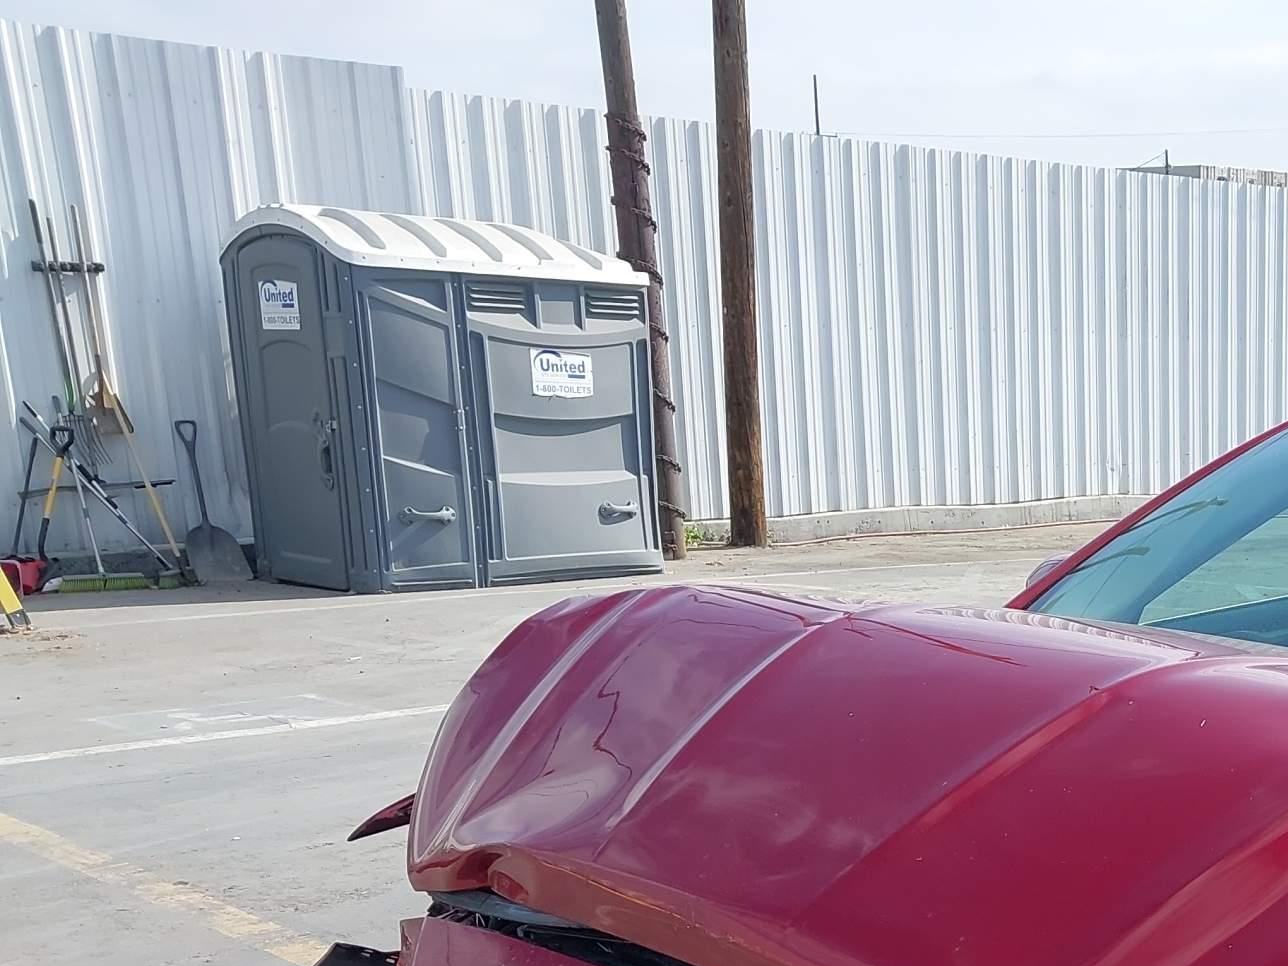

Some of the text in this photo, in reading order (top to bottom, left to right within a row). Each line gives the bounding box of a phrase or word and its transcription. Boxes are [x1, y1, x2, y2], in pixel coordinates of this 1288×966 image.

[263, 287, 295, 303] United
[539, 357, 586, 374] United
[535, 384, 592, 395] 1-800-TOILETS
